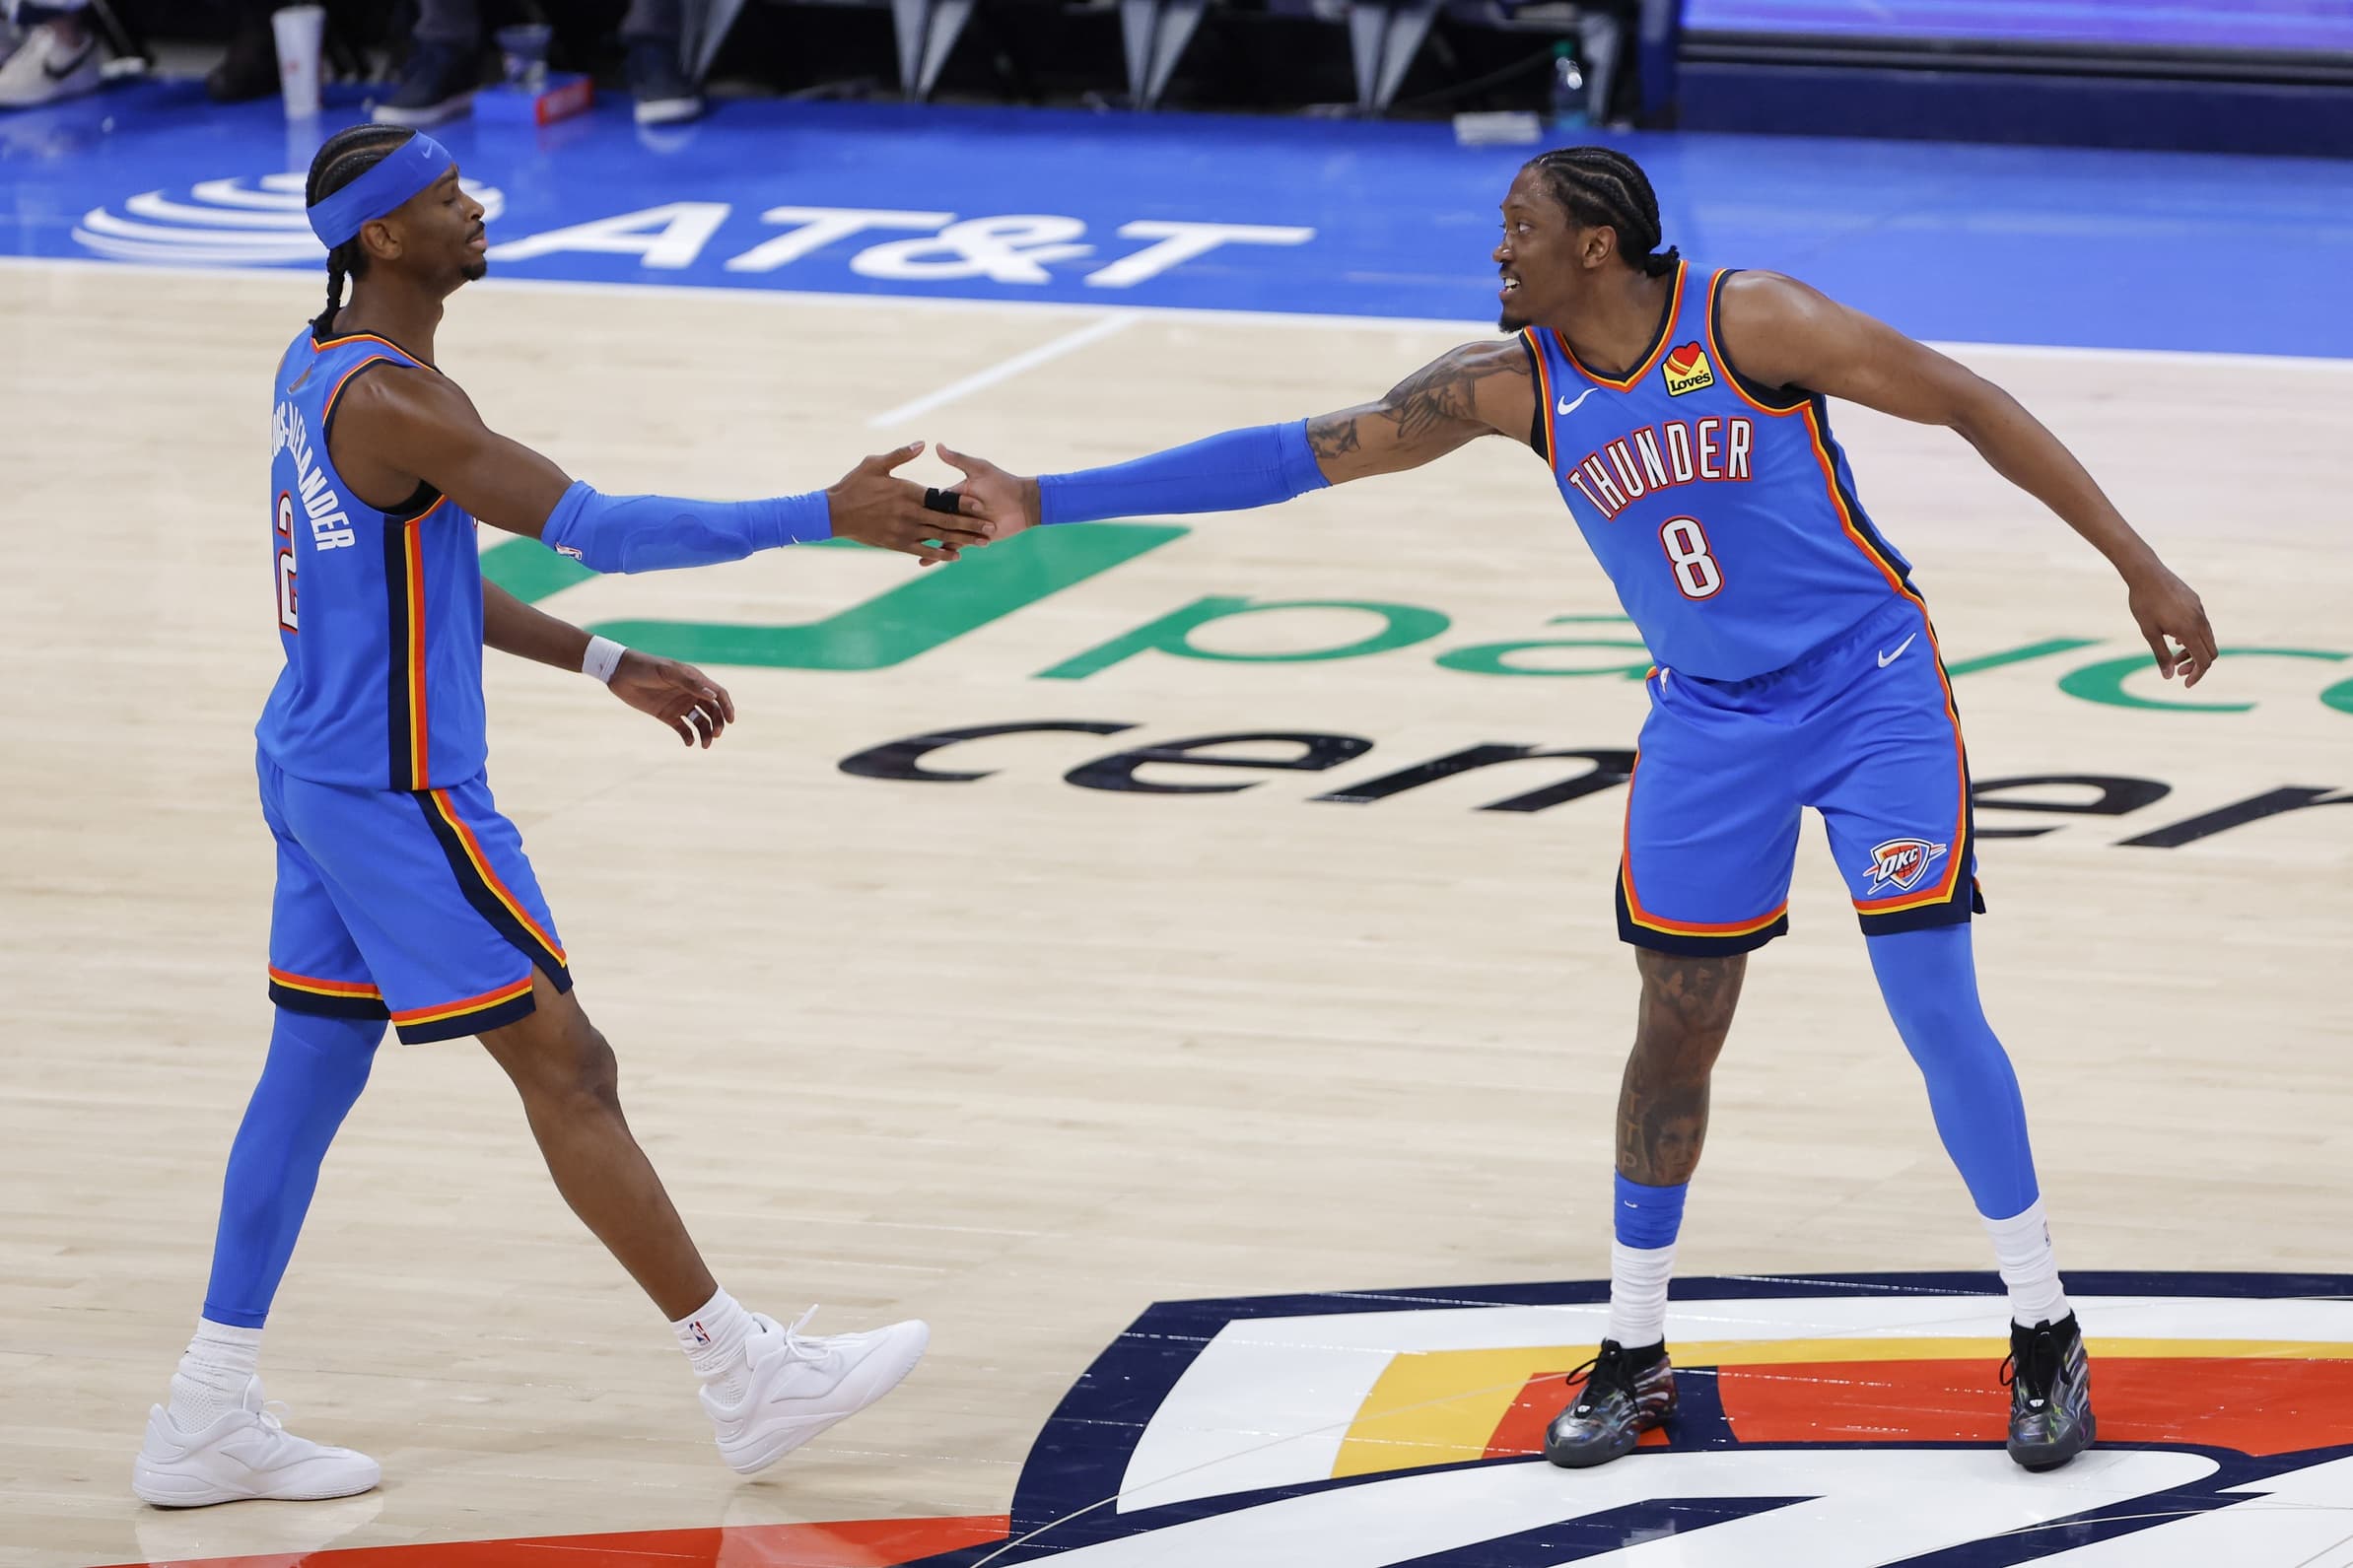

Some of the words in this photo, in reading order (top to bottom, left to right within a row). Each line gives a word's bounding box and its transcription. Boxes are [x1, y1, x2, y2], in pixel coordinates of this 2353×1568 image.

[484, 200, 1317, 289] AT&T
[1566, 415, 1755, 523] THUNDER
[1657, 514, 1726, 602] 8
[837, 719, 2353, 850] cener
[1876, 847, 1919, 883] OKC
